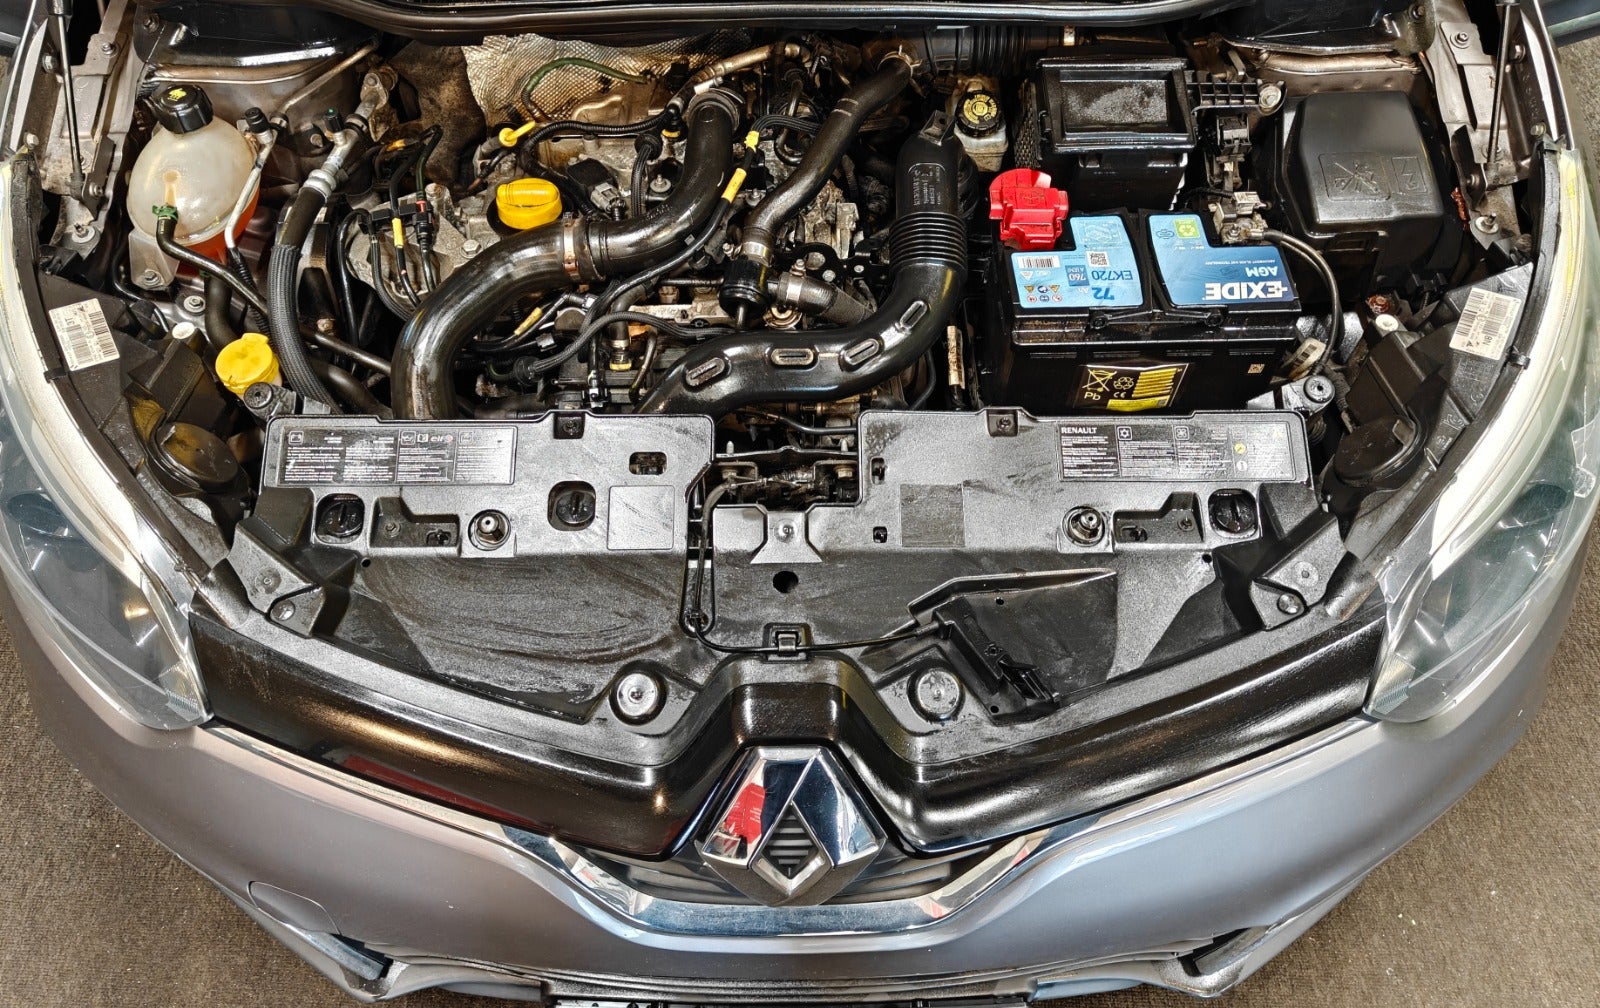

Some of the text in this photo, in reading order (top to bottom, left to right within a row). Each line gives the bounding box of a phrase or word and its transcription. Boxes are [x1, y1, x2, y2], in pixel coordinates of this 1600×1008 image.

[1068, 273, 1087, 281] 760
[1091, 270, 1133, 281] EK720
[1245, 266, 1278, 277] AGM
[1092, 287, 1115, 300] 72
[1205, 281, 1287, 300] EXIDE
[1084, 392, 1101, 400] Pb
